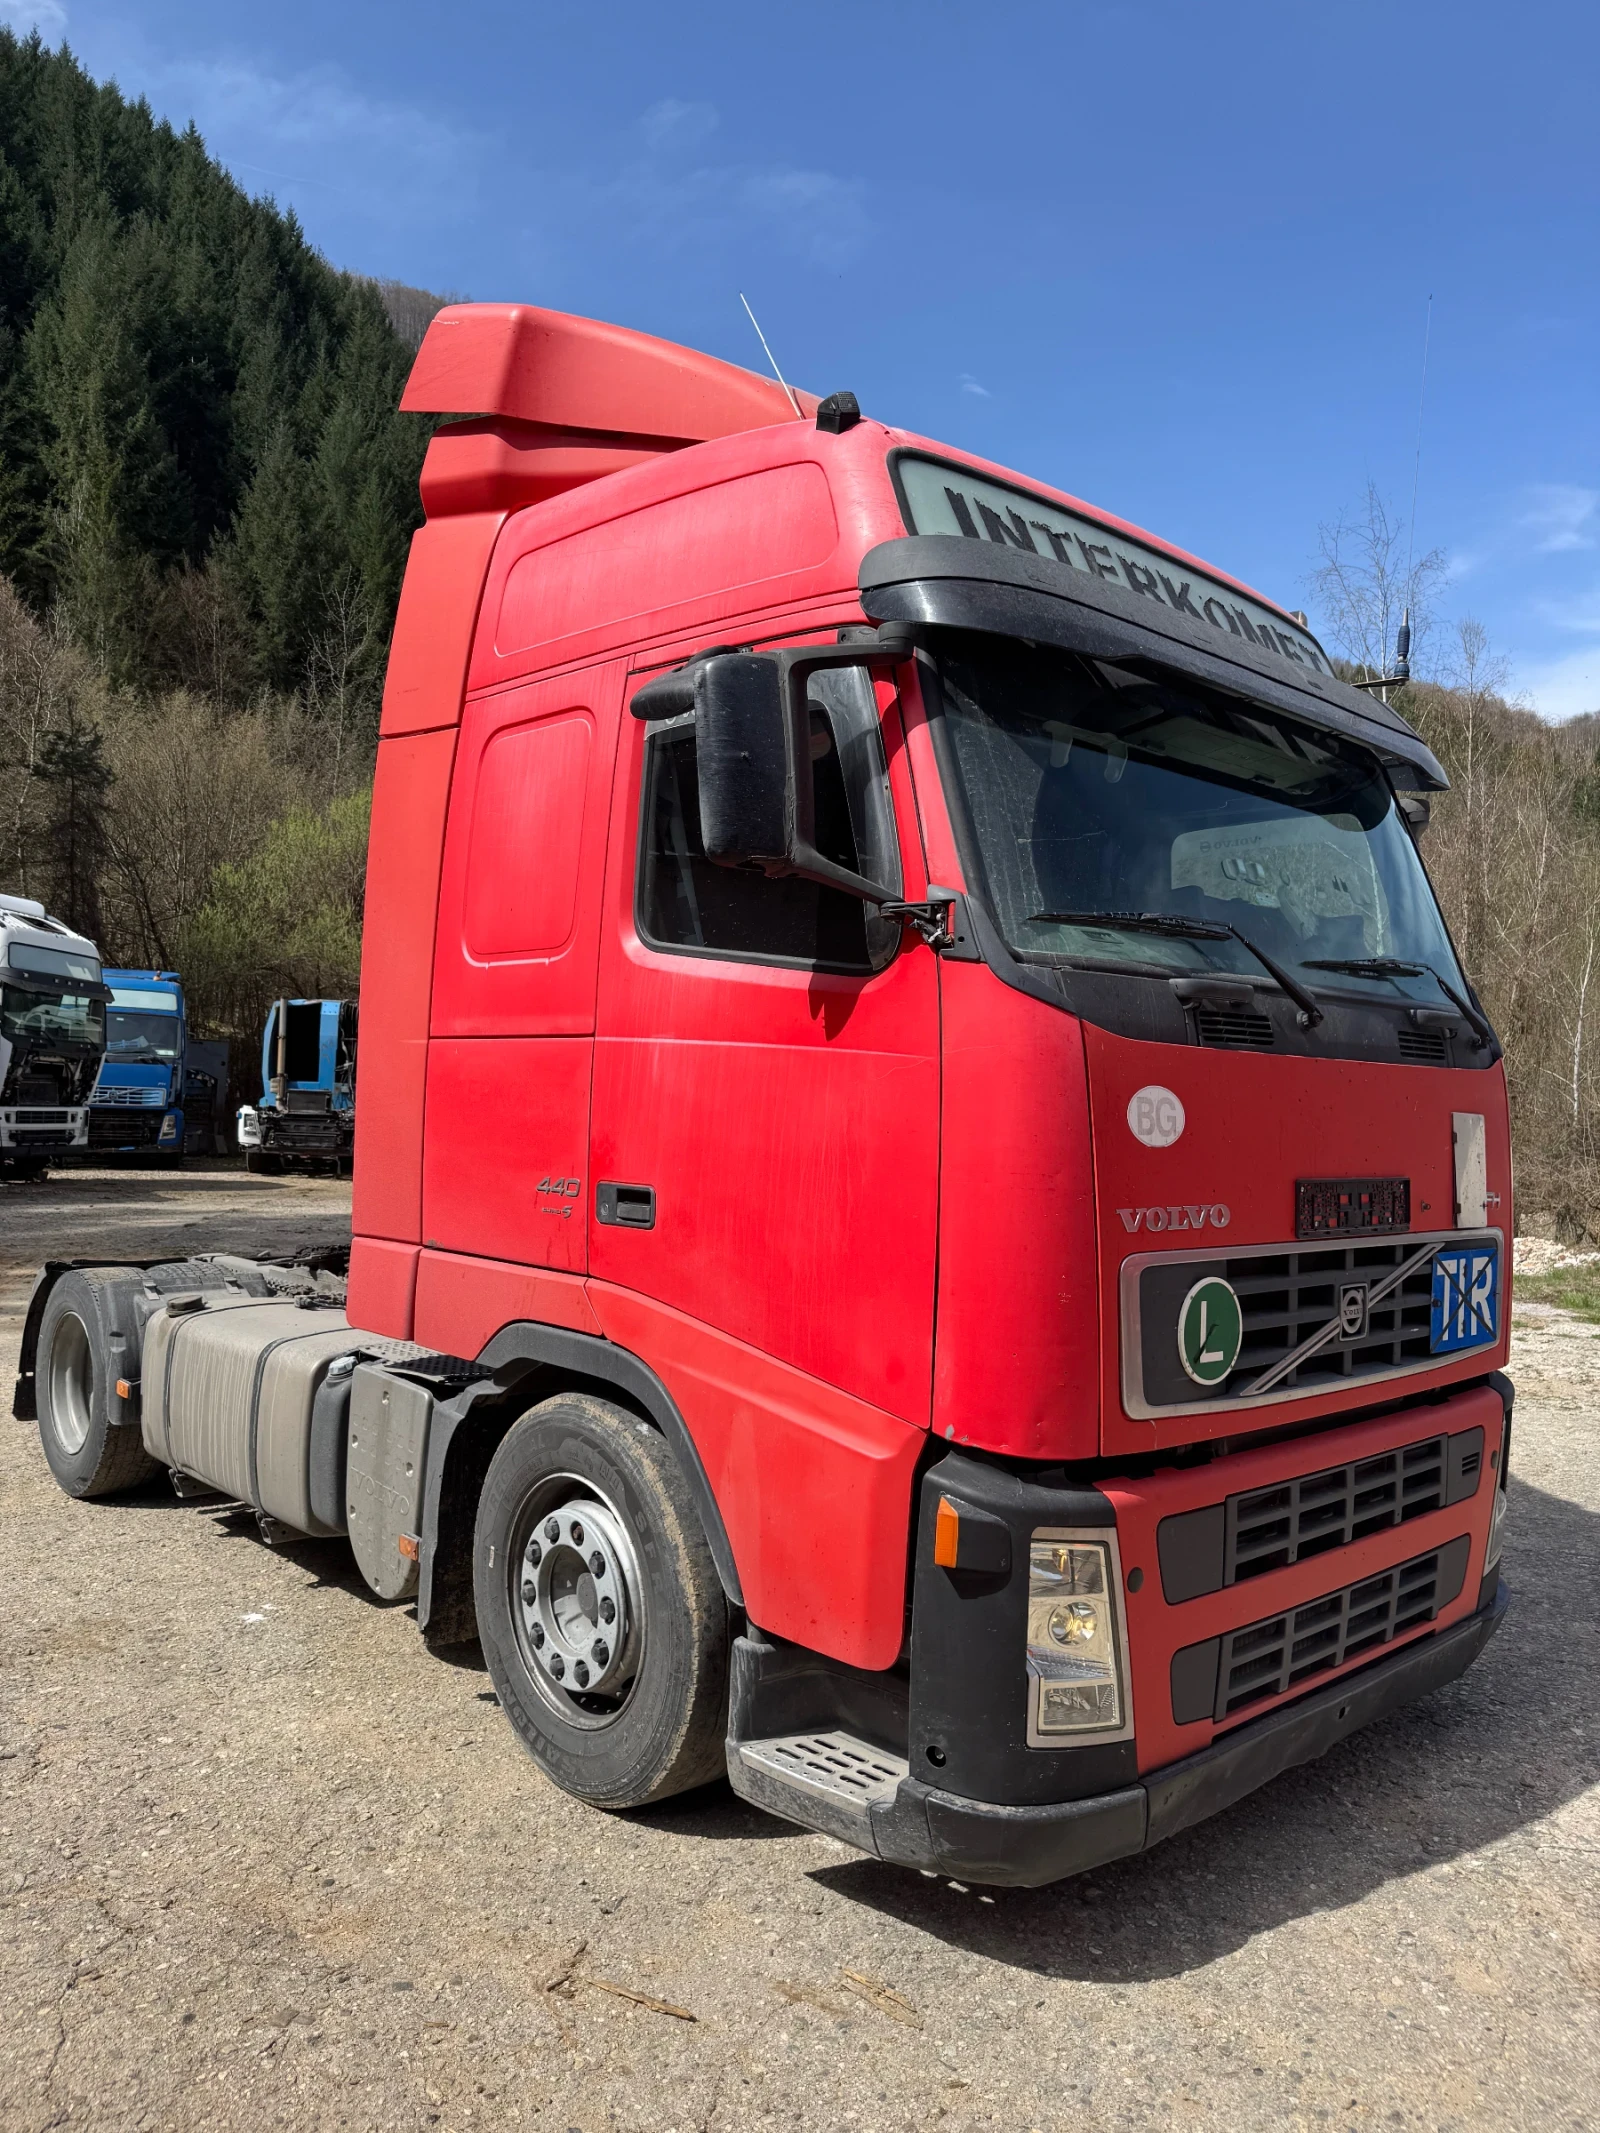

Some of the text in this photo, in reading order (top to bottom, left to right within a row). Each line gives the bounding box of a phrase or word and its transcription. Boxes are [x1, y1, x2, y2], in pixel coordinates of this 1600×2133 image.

[1136, 1096, 1178, 1138] BG
[536, 1176, 581, 1197] 440
[1116, 1203, 1231, 1233] VOLVO
[1436, 1256, 1493, 1341] TIR
[1200, 1300, 1224, 1363] L
[351, 1467, 410, 1516] VOLVO
